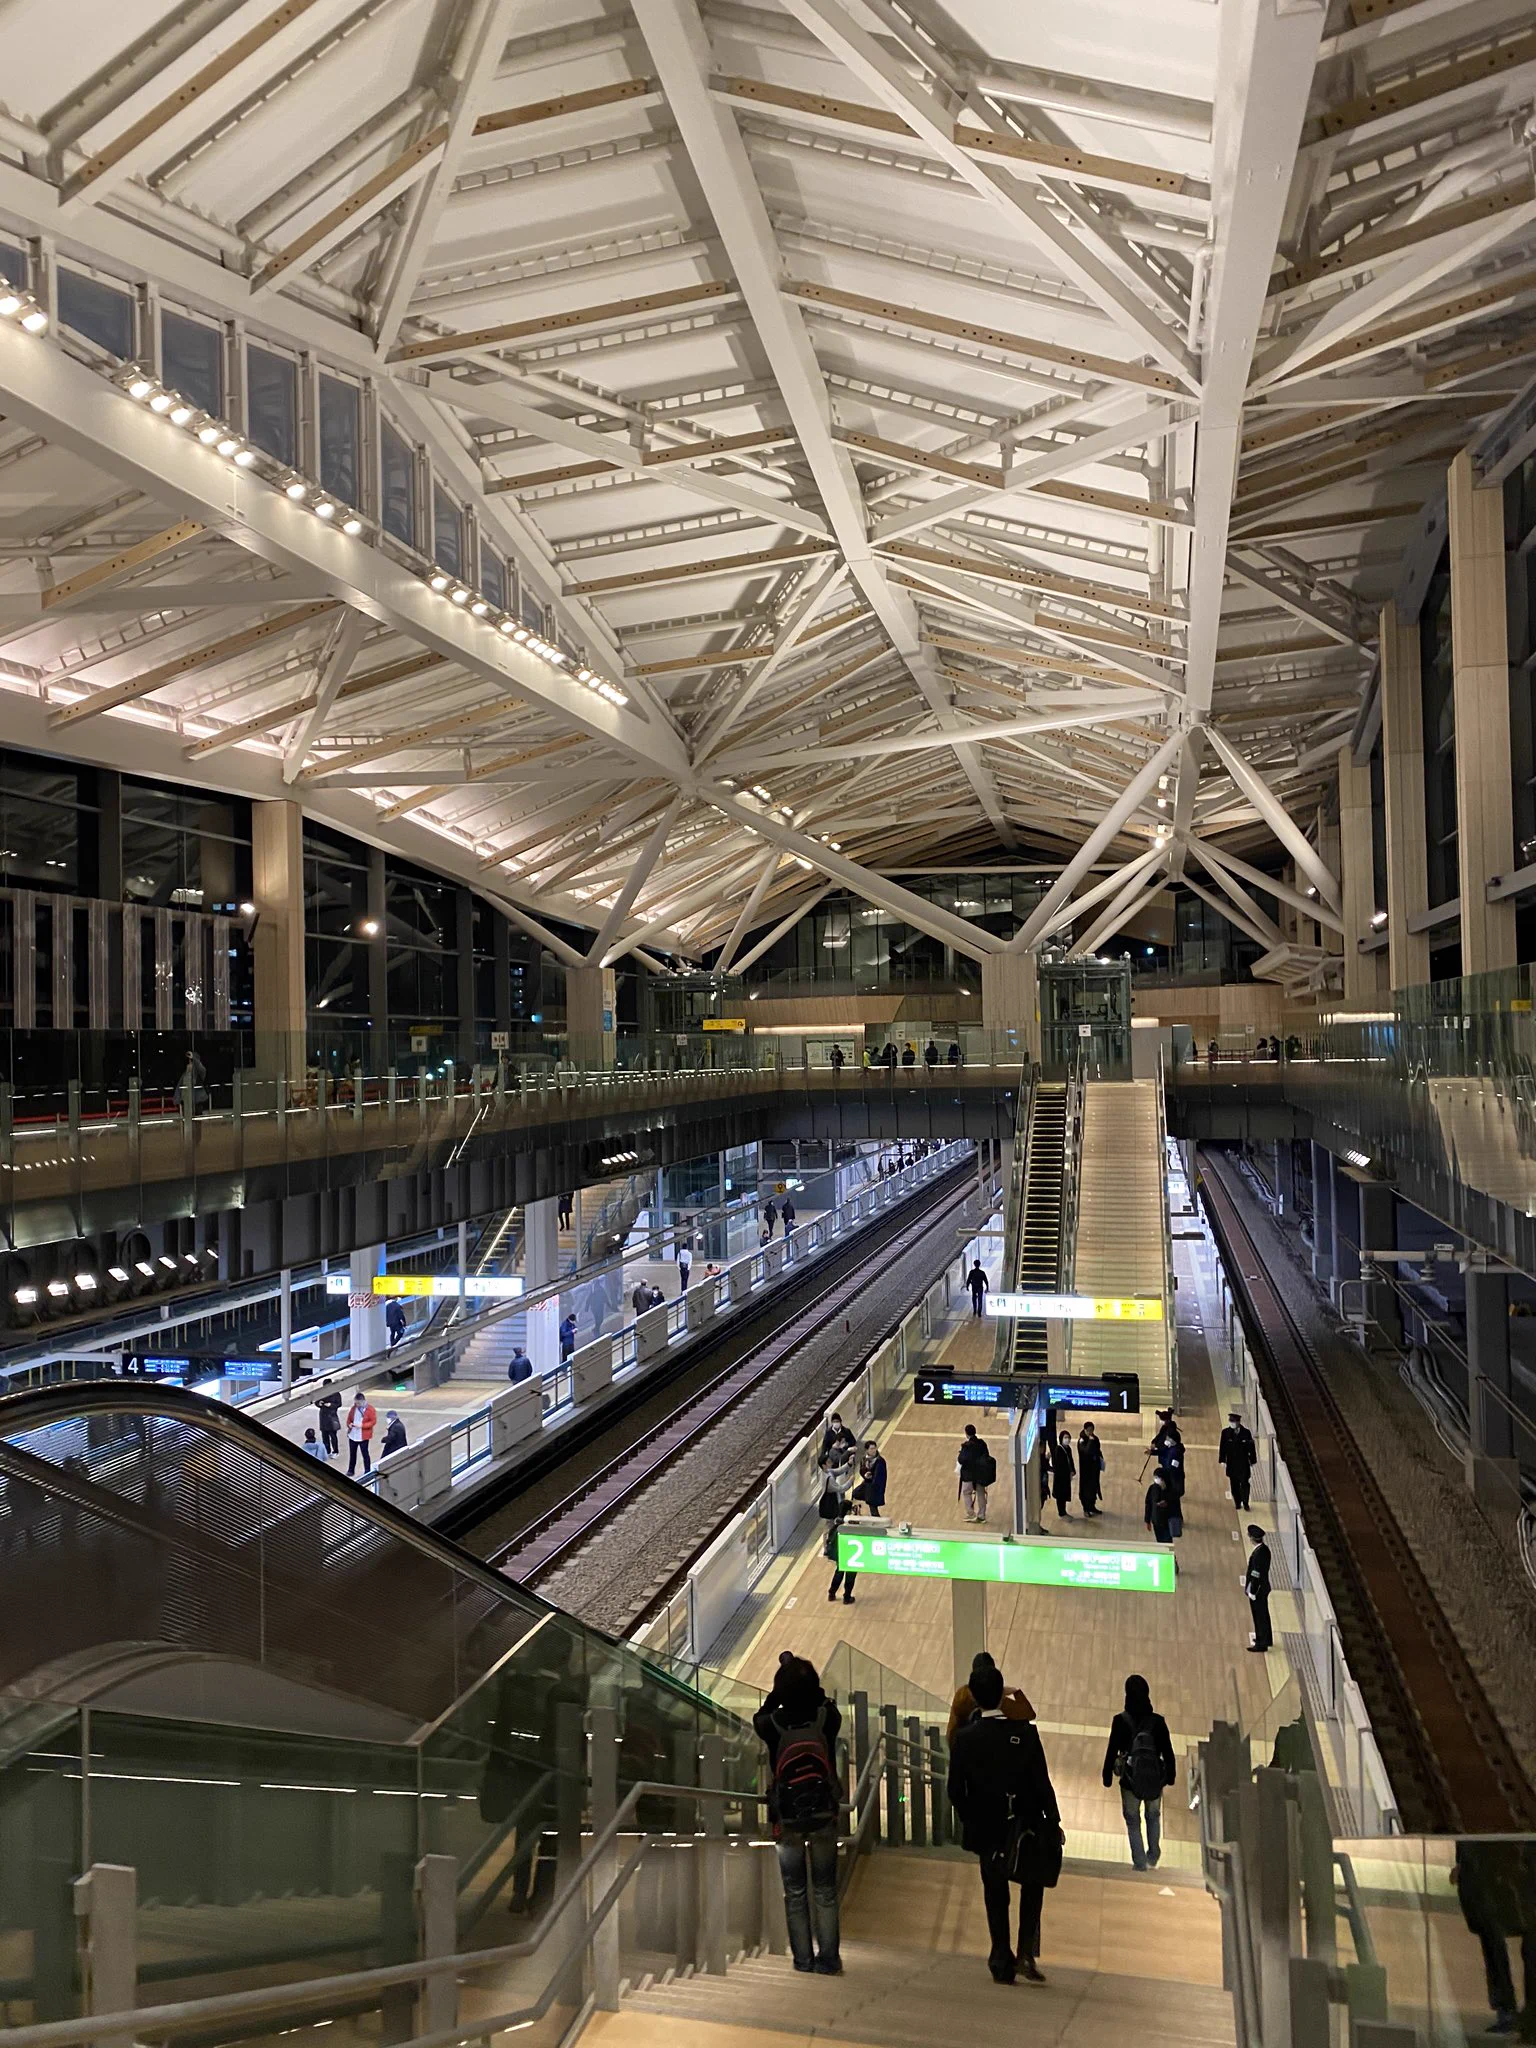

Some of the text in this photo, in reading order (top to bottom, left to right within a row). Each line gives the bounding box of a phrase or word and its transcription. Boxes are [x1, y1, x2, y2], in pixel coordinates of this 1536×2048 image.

[128, 1357, 139, 1374] 4
[922, 1381, 936, 1402] 2
[1119, 1390, 1128, 1410] 1
[846, 1539, 865, 1568] 2
[1147, 1557, 1160, 1587] 1
